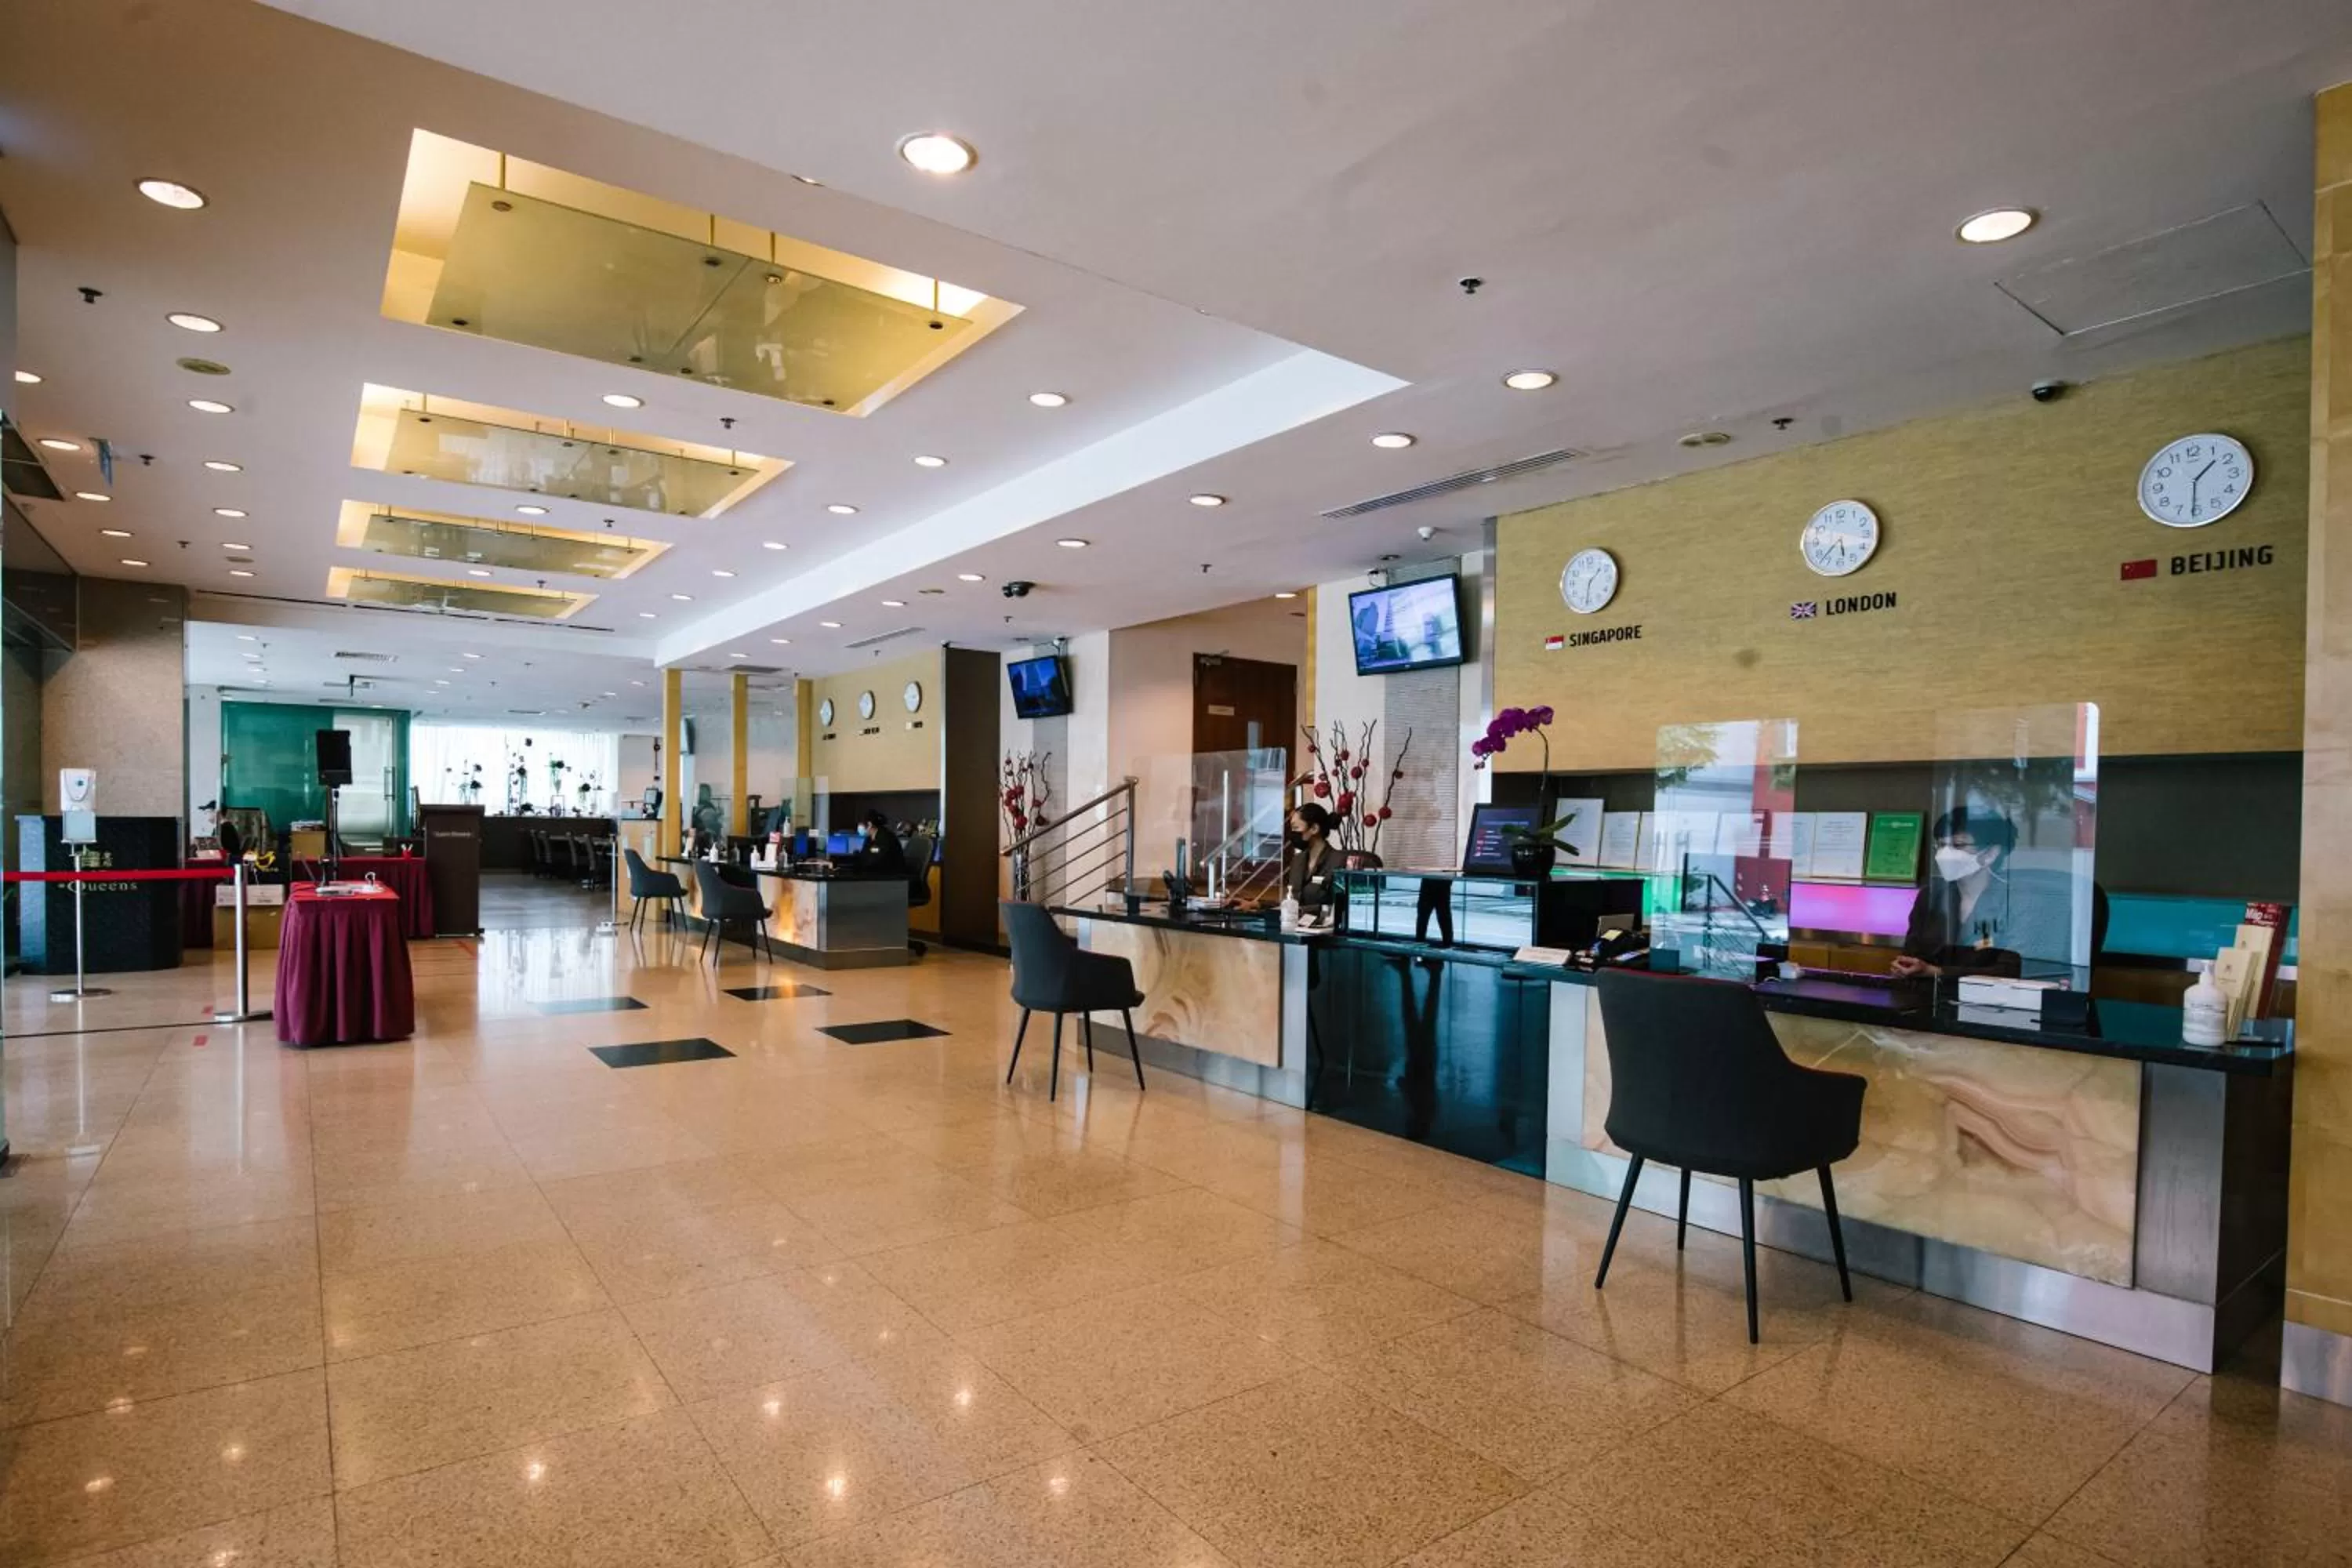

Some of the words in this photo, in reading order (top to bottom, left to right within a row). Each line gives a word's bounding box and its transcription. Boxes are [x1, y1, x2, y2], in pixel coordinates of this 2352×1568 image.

[2186, 445, 2201, 457] 12
[2169, 454, 2180, 464] 11
[2222, 452, 2234, 465] 2
[2157, 466, 2172, 478] 10
[2227, 466, 2240, 479] 3
[2152, 482, 2163, 494] 9
[2223, 483, 2234, 493] 4
[2159, 496, 2171, 507] 8
[2211, 497, 2222, 508] 5
[2175, 504, 2183, 515] 7
[2171, 545, 2274, 575] BEIJING
[1826, 592, 1896, 615] LONDON
[1569, 625, 1642, 647] SINGAPORE
